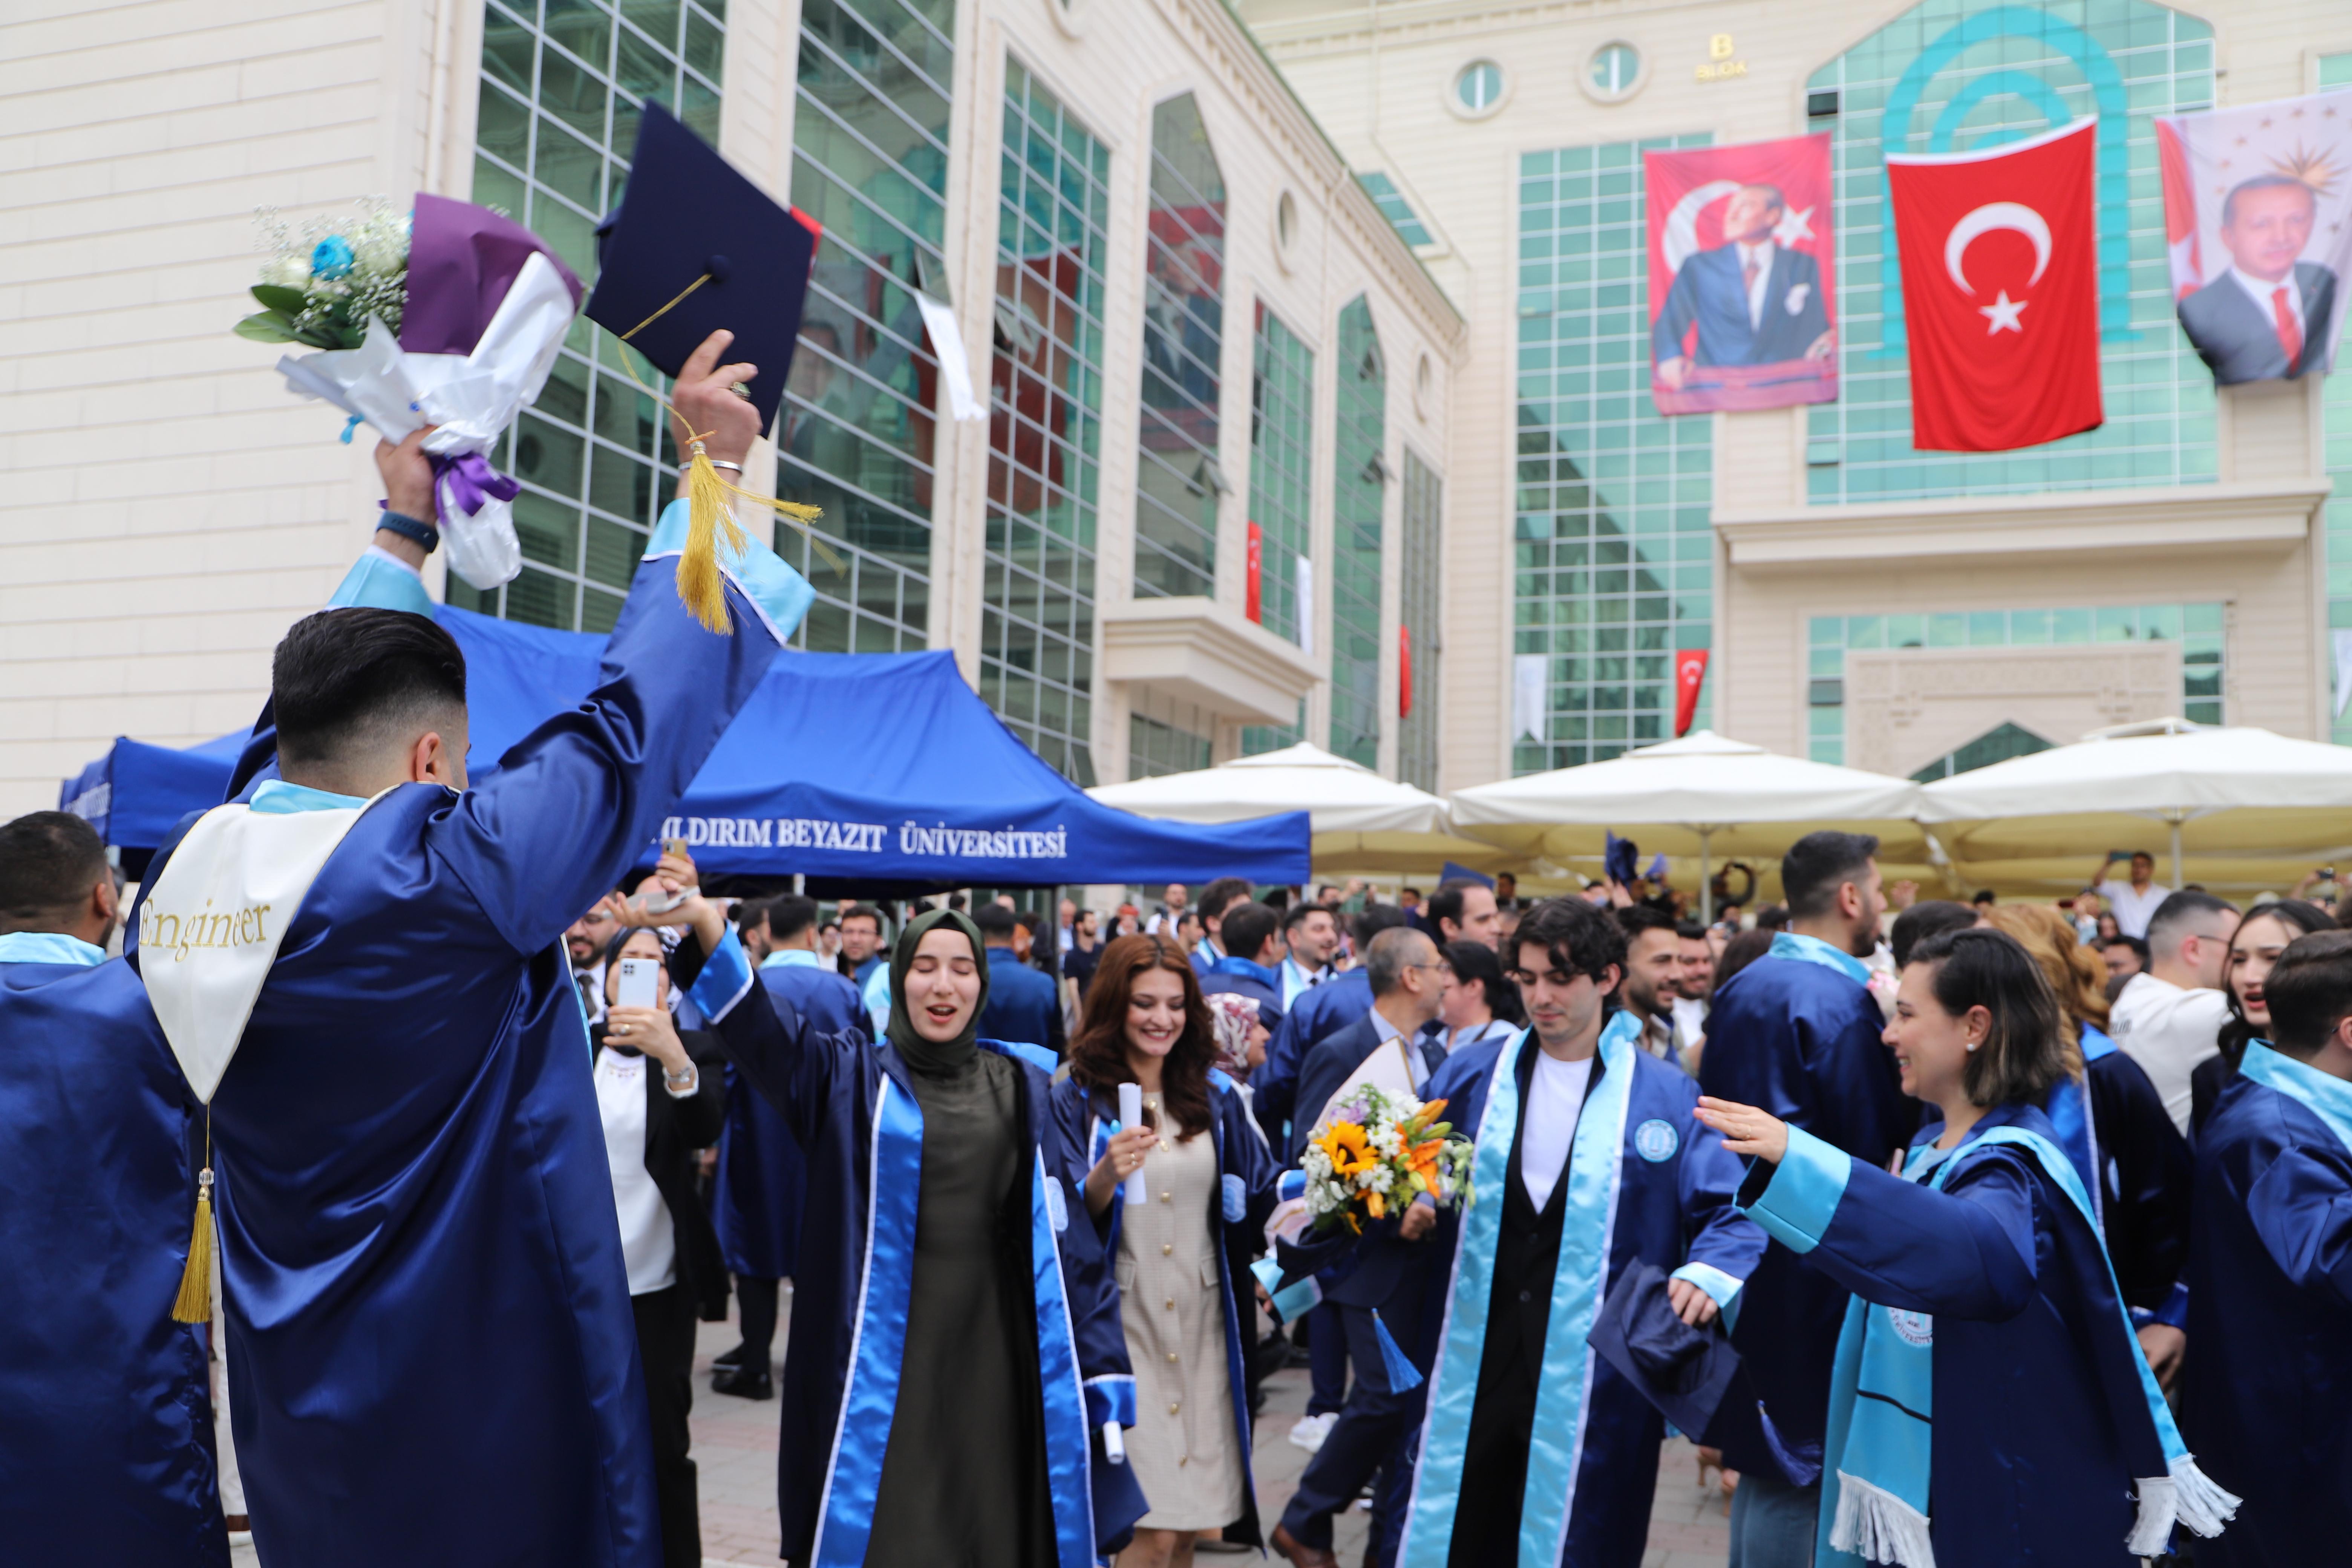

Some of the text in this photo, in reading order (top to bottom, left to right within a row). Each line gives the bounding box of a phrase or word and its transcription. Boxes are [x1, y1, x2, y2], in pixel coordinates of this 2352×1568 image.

[1709, 34, 1734, 61] B
[651, 816, 1067, 858] ILDIRIM BEYAZIT ÜNİVERSİTESİ
[139, 897, 271, 962] Engineer
